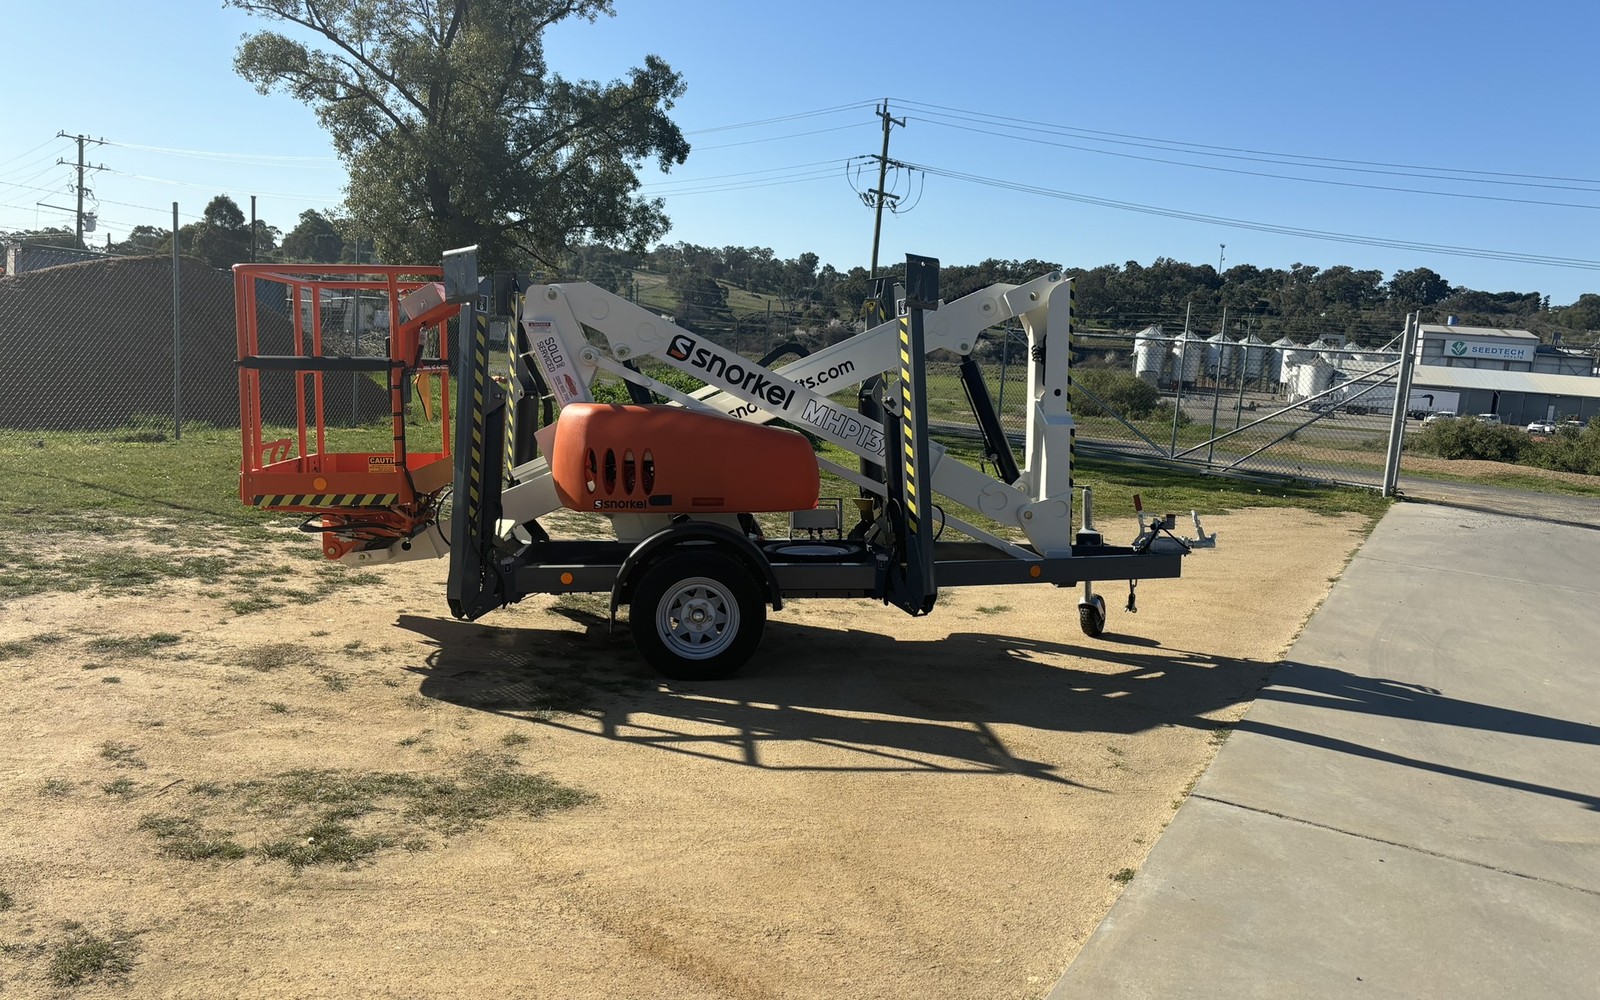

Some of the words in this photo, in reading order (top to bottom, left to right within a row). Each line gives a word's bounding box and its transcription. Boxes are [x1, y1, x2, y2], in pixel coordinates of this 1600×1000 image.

[537, 340, 556, 373] SERVICED
[545, 337, 563, 364] SOLD
[1472, 346, 1525, 356] SEEDTECH
[691, 348, 796, 411] snorkel
[801, 398, 886, 458] MHP13
[603, 500, 647, 509] snorkel
